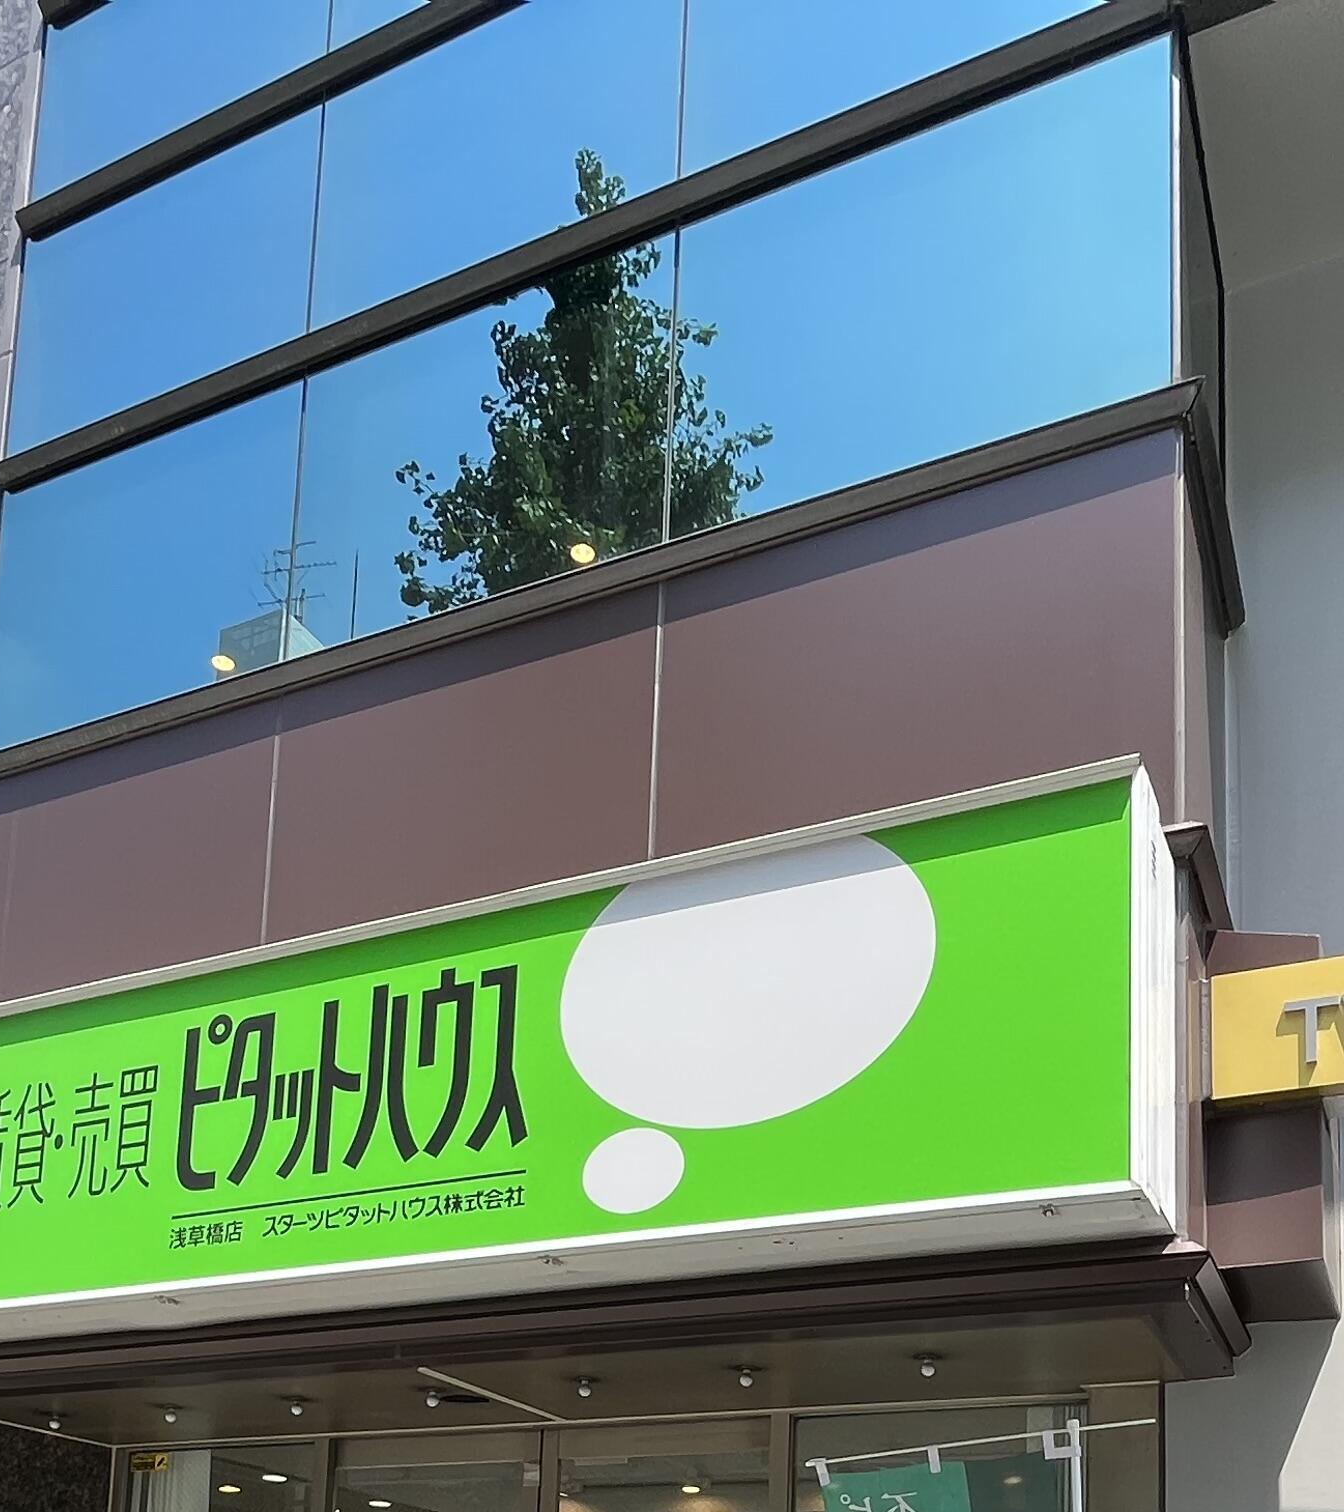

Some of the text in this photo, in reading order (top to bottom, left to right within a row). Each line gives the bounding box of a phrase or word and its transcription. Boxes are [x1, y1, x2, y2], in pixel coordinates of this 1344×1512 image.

[176, 963, 529, 1191] ピタットハウス
[168, 1184, 526, 1250] 浅草橋店 スターツピタットハウス株式会社
